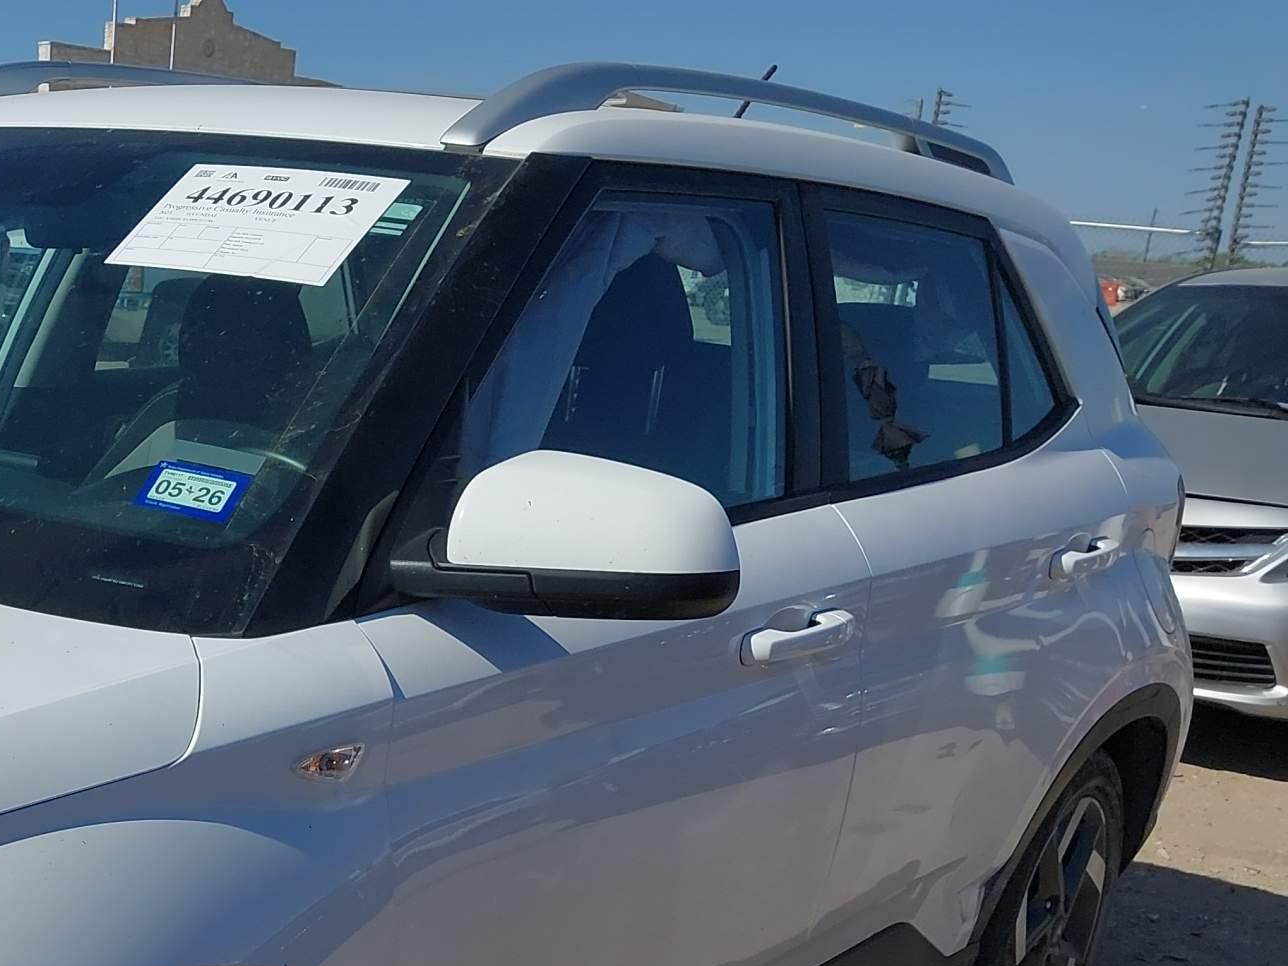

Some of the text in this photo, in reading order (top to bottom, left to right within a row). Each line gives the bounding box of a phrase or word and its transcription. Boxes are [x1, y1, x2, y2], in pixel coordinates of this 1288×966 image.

[185, 185, 359, 216] 44690113
[155, 480, 186, 497] 05
[192, 487, 225, 506] 26
